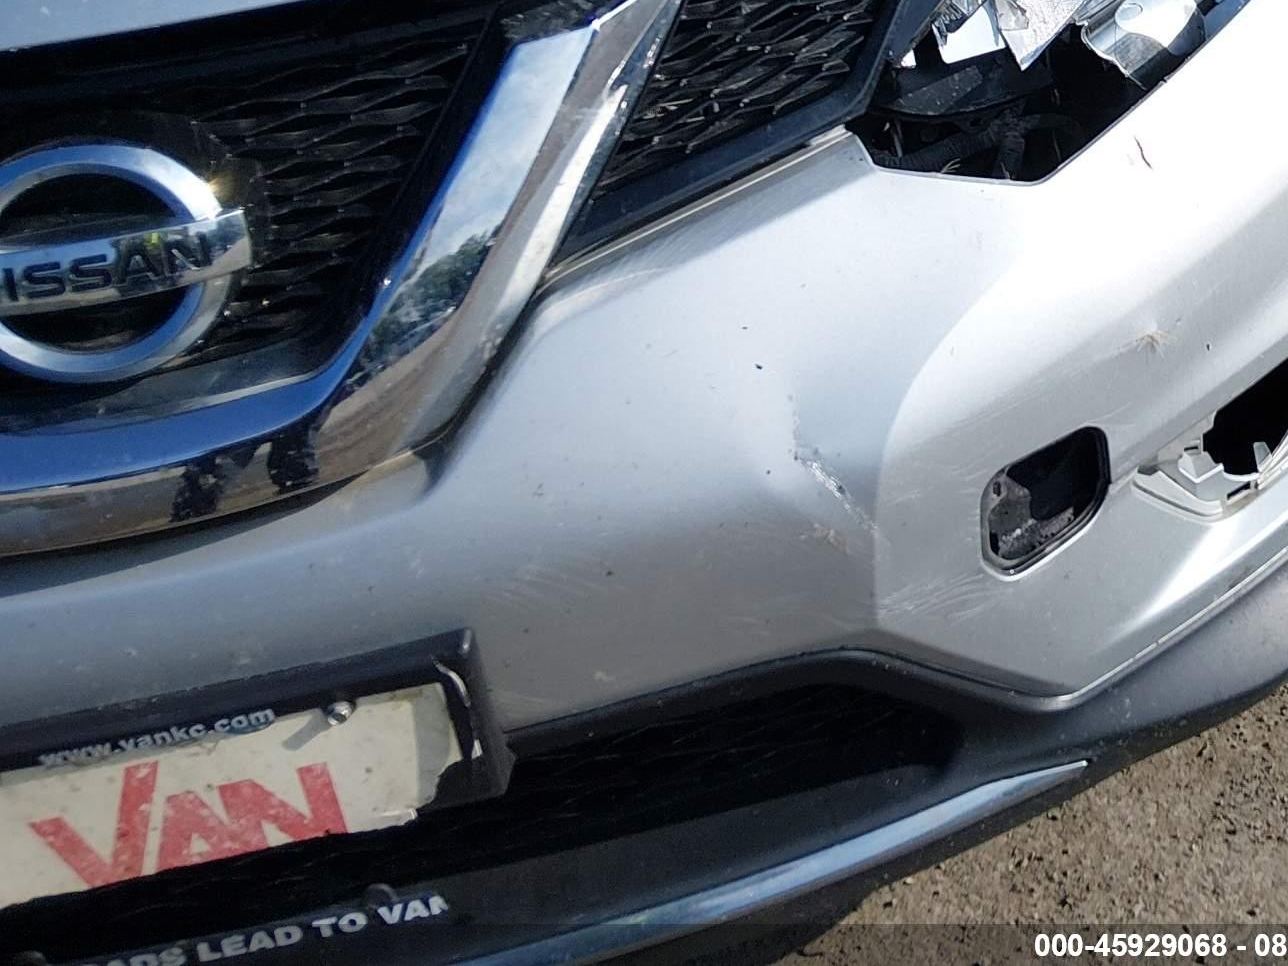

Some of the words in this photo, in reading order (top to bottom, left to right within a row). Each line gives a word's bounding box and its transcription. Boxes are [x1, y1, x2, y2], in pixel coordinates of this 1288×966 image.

[38, 707, 277, 766] www.vankc.com
[29, 760, 348, 890] VAN
[196, 925, 303, 962] LEAD
[311, 911, 369, 938] TO
